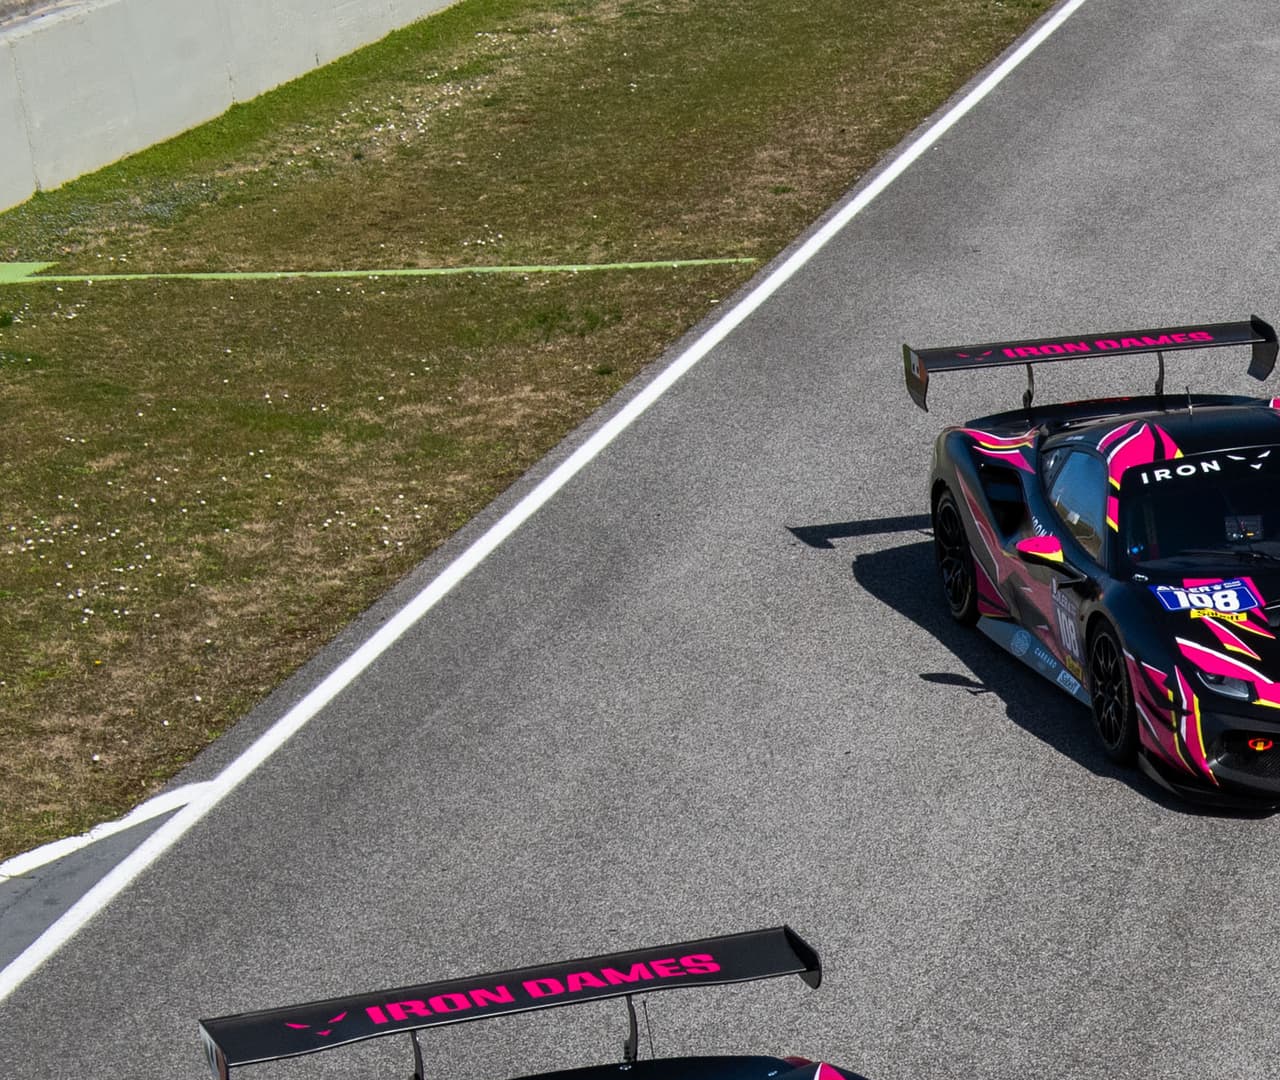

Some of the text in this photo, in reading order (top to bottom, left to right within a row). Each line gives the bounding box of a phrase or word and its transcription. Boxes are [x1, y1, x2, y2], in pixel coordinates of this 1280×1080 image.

[1001, 331, 1214, 358] IRON DAMES
[1141, 460, 1221, 484] IRON
[1173, 588, 1241, 612] 108
[366, 952, 722, 1026] IRON DAMES
